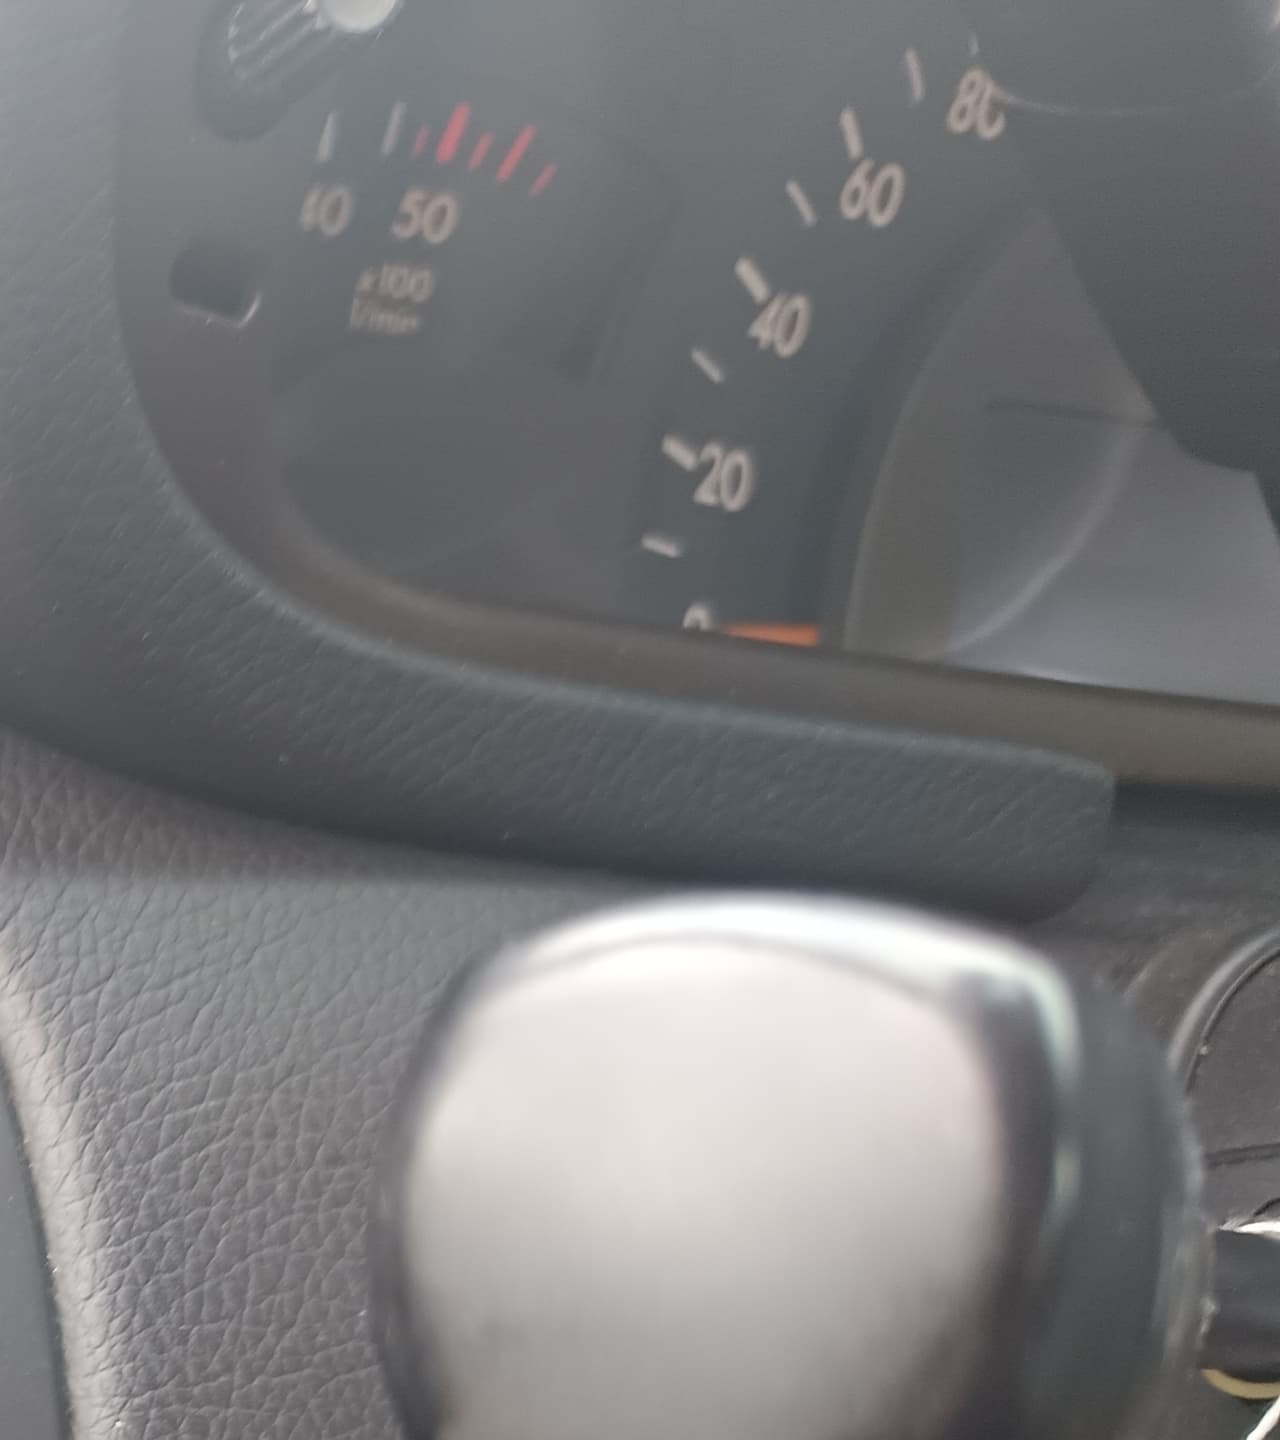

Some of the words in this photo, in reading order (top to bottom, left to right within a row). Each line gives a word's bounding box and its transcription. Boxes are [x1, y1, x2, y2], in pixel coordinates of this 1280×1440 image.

[392, 188, 458, 244] 50
[839, 160, 905, 228] 60
[749, 292, 808, 356] 40
[693, 443, 751, 511] 20
